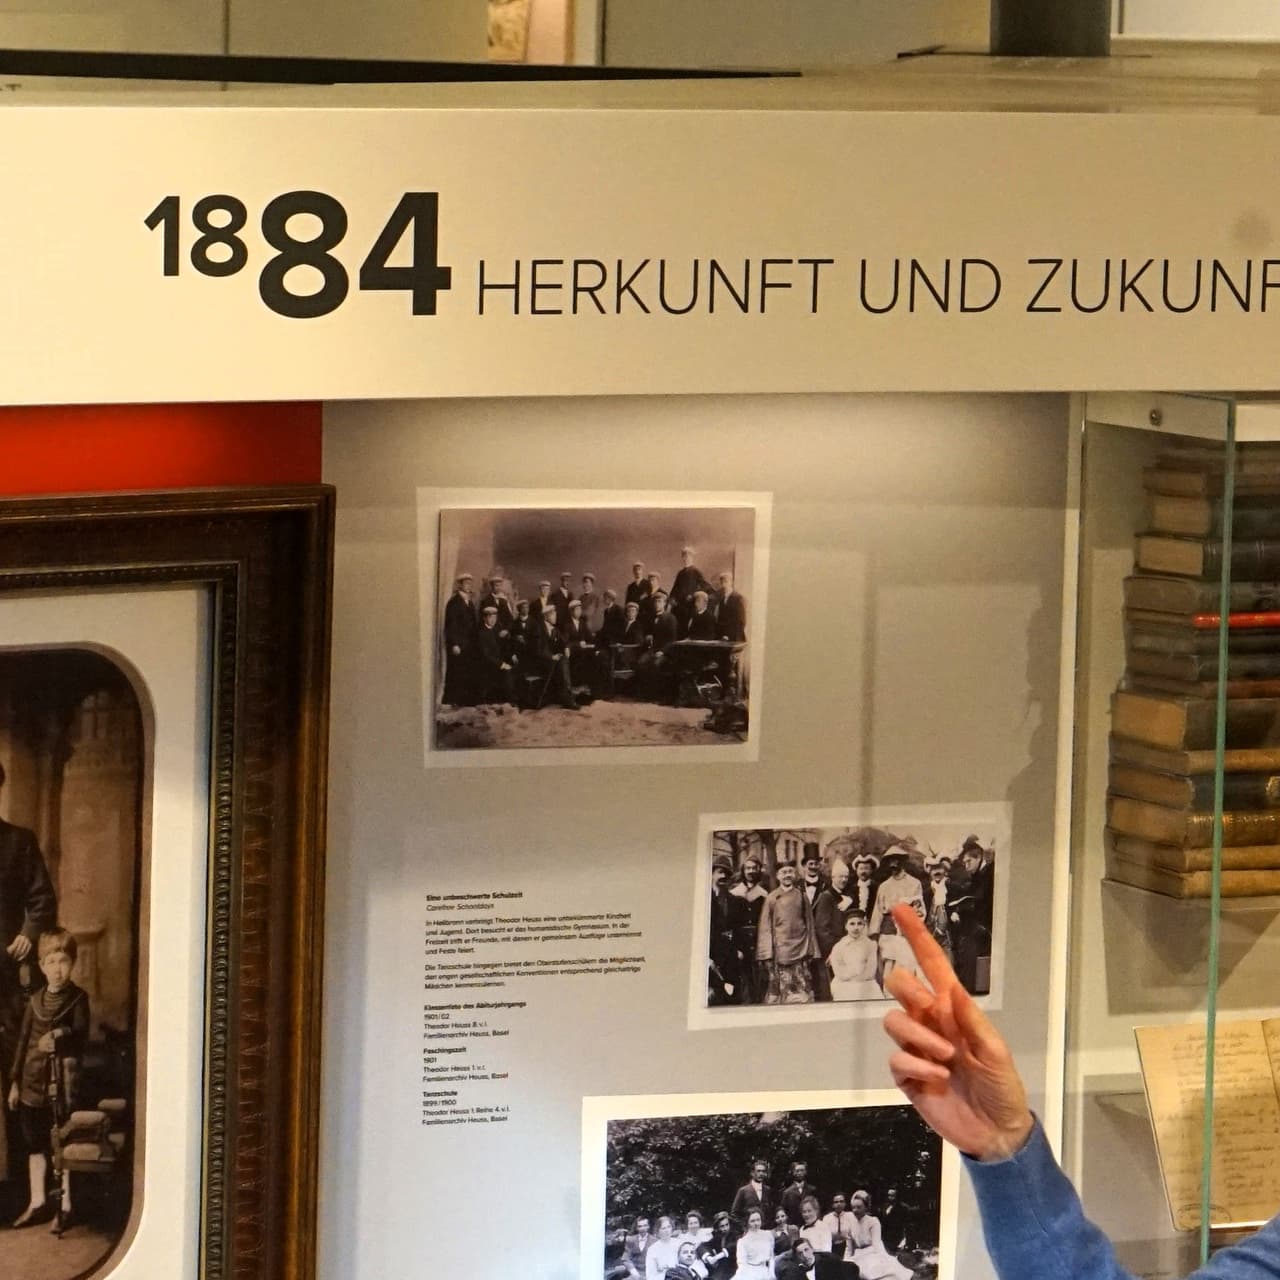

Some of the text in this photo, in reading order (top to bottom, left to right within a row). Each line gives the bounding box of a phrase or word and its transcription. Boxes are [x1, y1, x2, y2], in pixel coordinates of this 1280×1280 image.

[143, 190, 452, 319] 1884
[478, 258, 835, 316] HERKUNFT
[859, 257, 1003, 315] UND
